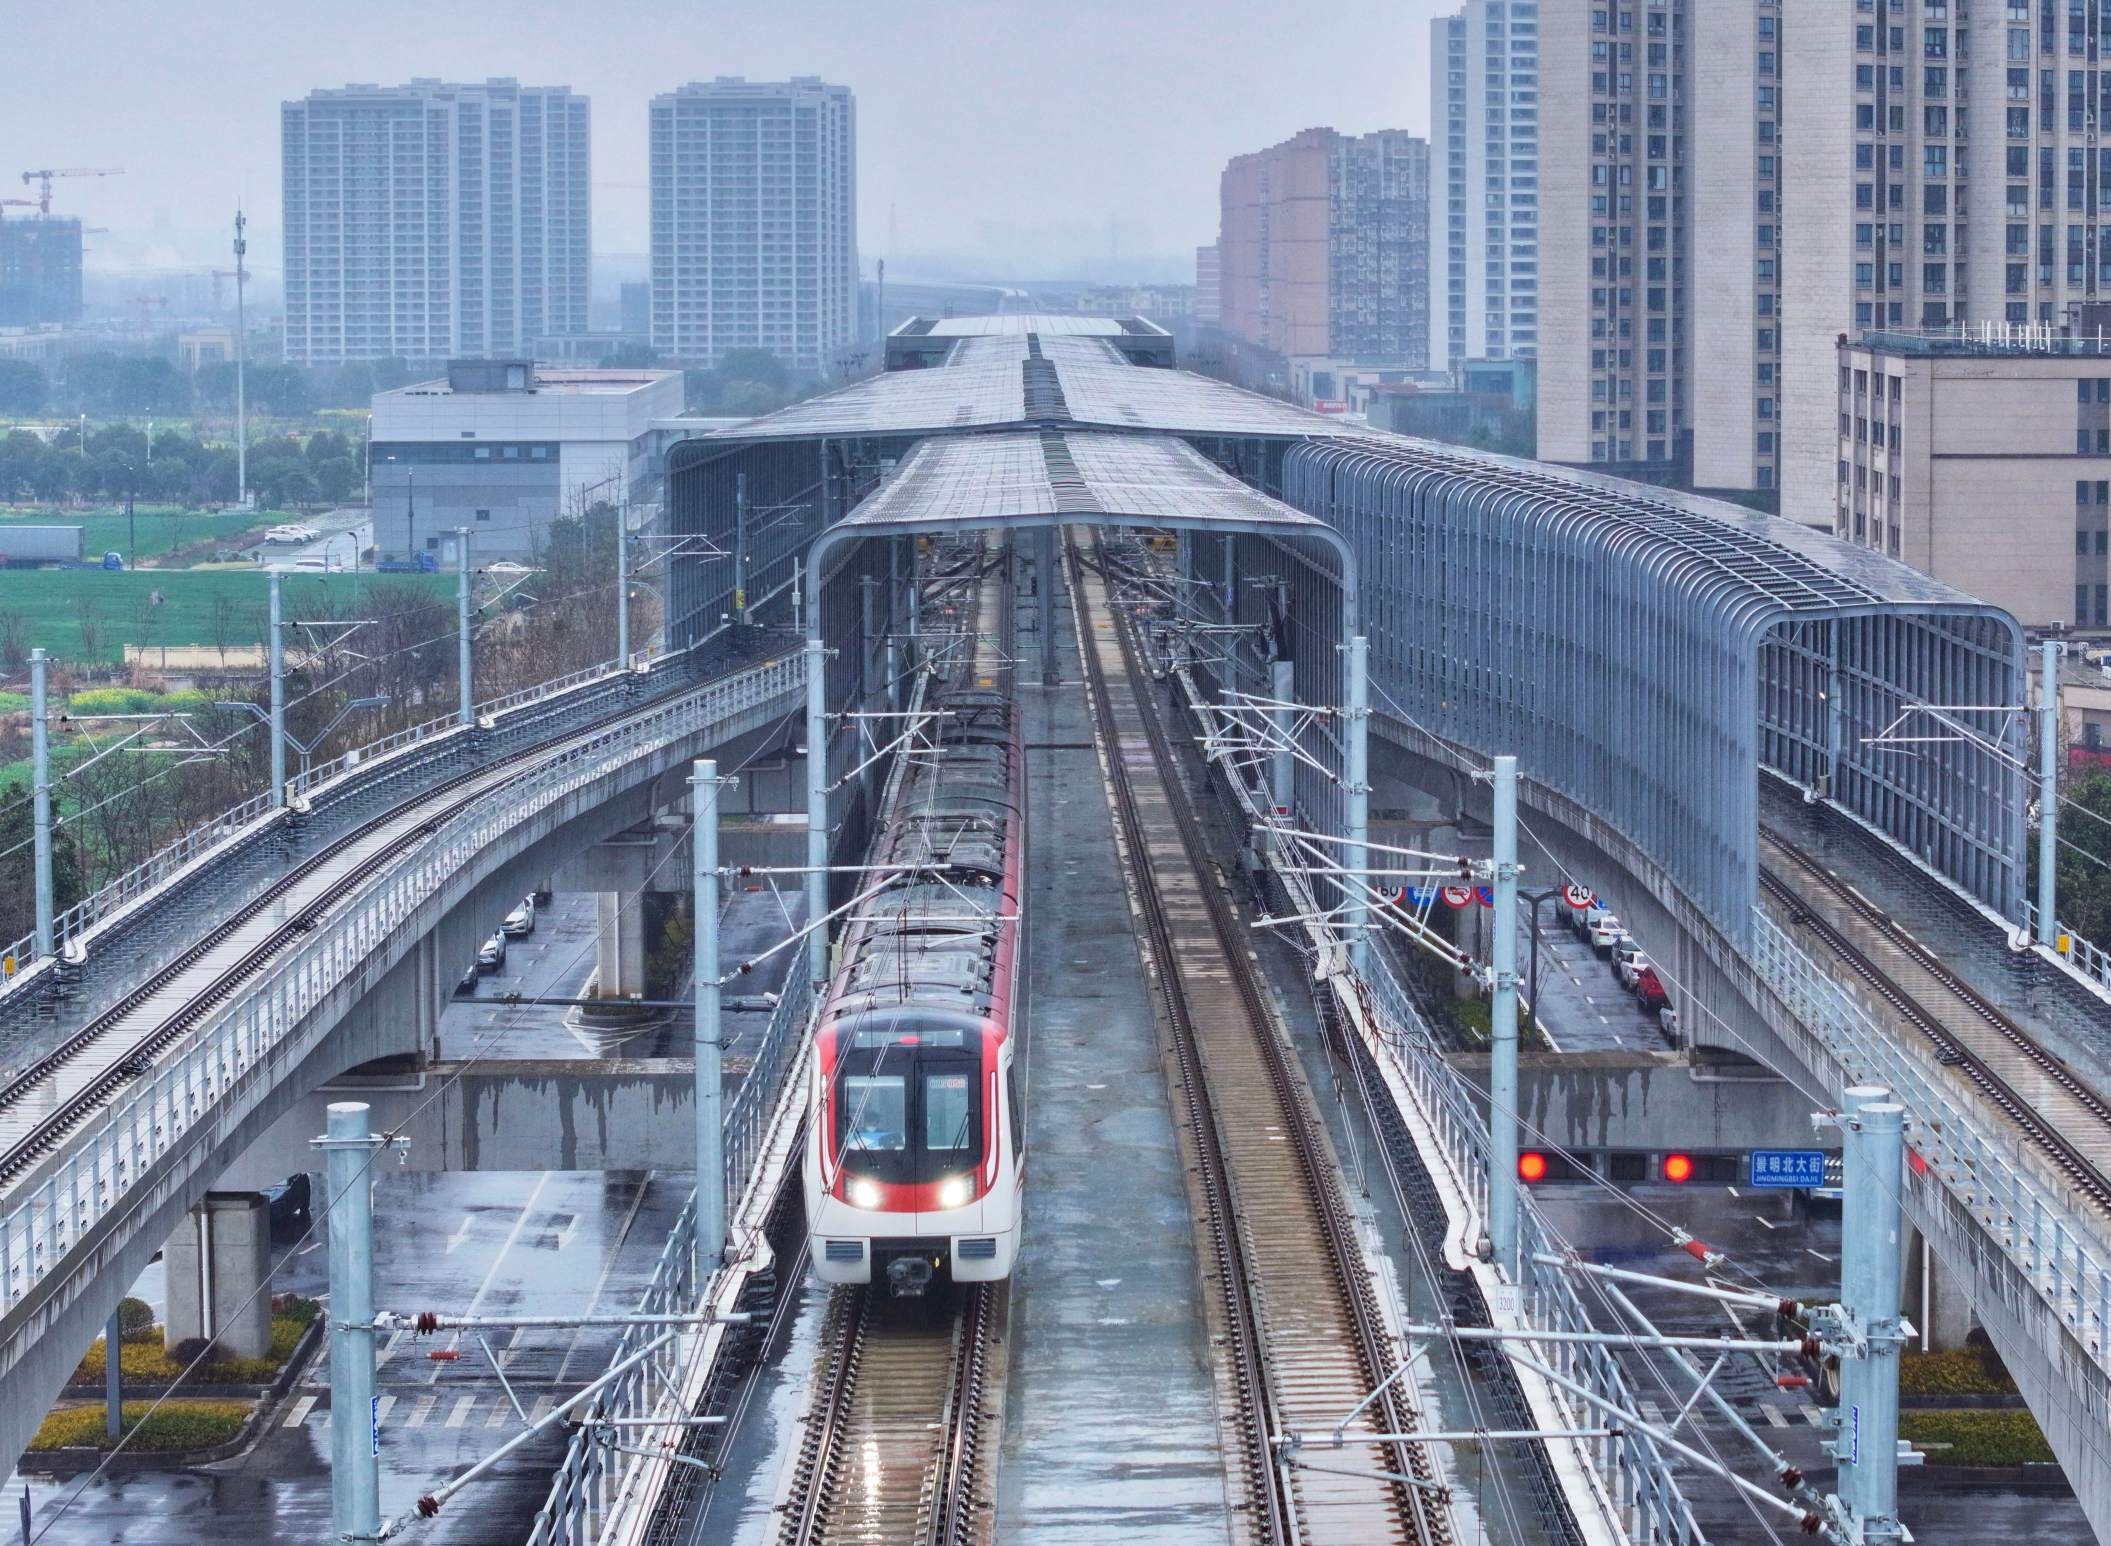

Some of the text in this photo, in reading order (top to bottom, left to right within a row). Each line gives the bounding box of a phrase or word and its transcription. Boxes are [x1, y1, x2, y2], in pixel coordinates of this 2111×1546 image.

[1570, 886, 1589, 900] 40
[1756, 1156, 1820, 1173] 景明北大街
